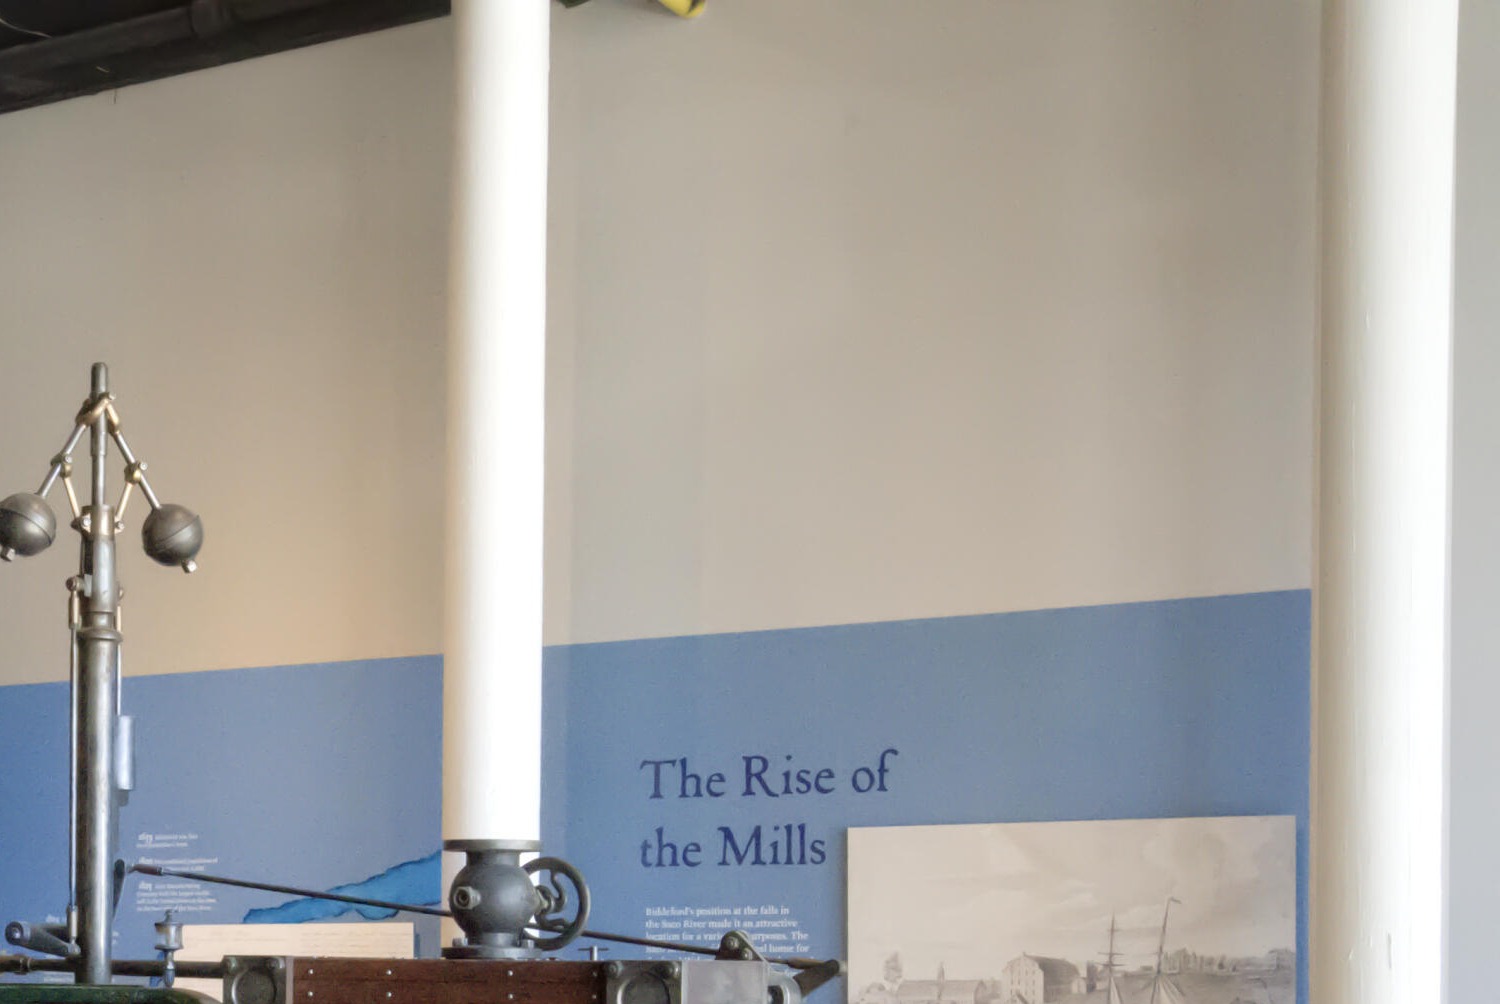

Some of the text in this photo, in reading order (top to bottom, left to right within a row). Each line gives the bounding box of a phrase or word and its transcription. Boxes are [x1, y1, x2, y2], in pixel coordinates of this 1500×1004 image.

[639, 748, 899, 800] The Rise of
[640, 823, 827, 868] the Mills
[696, 906, 732, 918] position
[733, 906, 742, 916] at
[743, 905, 759, 916] the
[759, 904, 779, 916] falls
[780, 904, 790, 915] in
[645, 919, 660, 929] the
[683, 919, 707, 929] River
[708, 918, 732, 929] made
[733, 918, 741, 928] it
[742, 920, 754, 928] an
[755, 918, 798, 928] attractive
[681, 931, 695, 941] for
[791, 930, 809, 941] The
[769, 943, 794, 953] home
[796, 943, 810, 953] for
